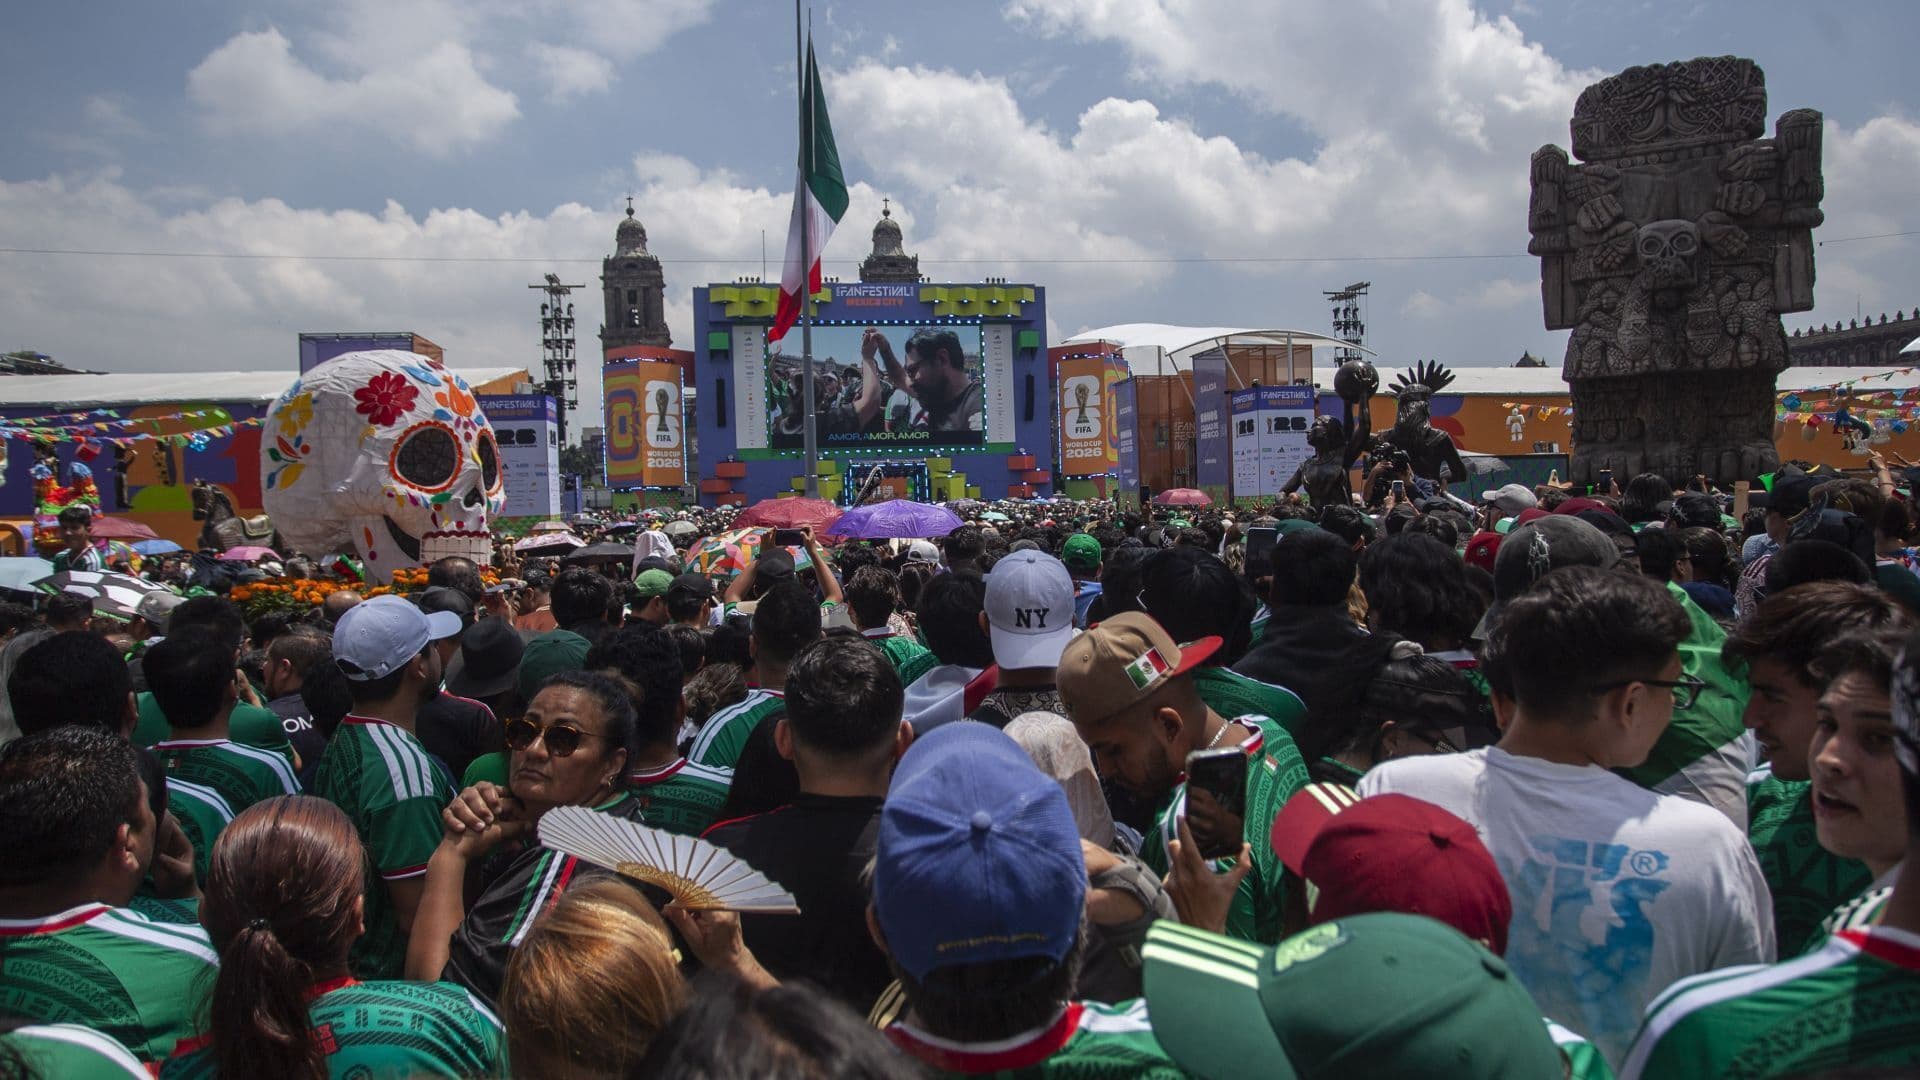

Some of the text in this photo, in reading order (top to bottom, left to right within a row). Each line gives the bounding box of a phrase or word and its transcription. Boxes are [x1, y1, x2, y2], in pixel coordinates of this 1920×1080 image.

[1075, 426, 1092, 434] FIFA
[656, 434, 672, 442] FIFA
[863, 431, 897, 441] AMOR,
[898, 431, 930, 440] AMOR
[1065, 441, 1088, 449] WORLD
[1066, 447, 1102, 459] 2026
[647, 458, 681, 468] 2026
[1015, 607, 1050, 629] NY
